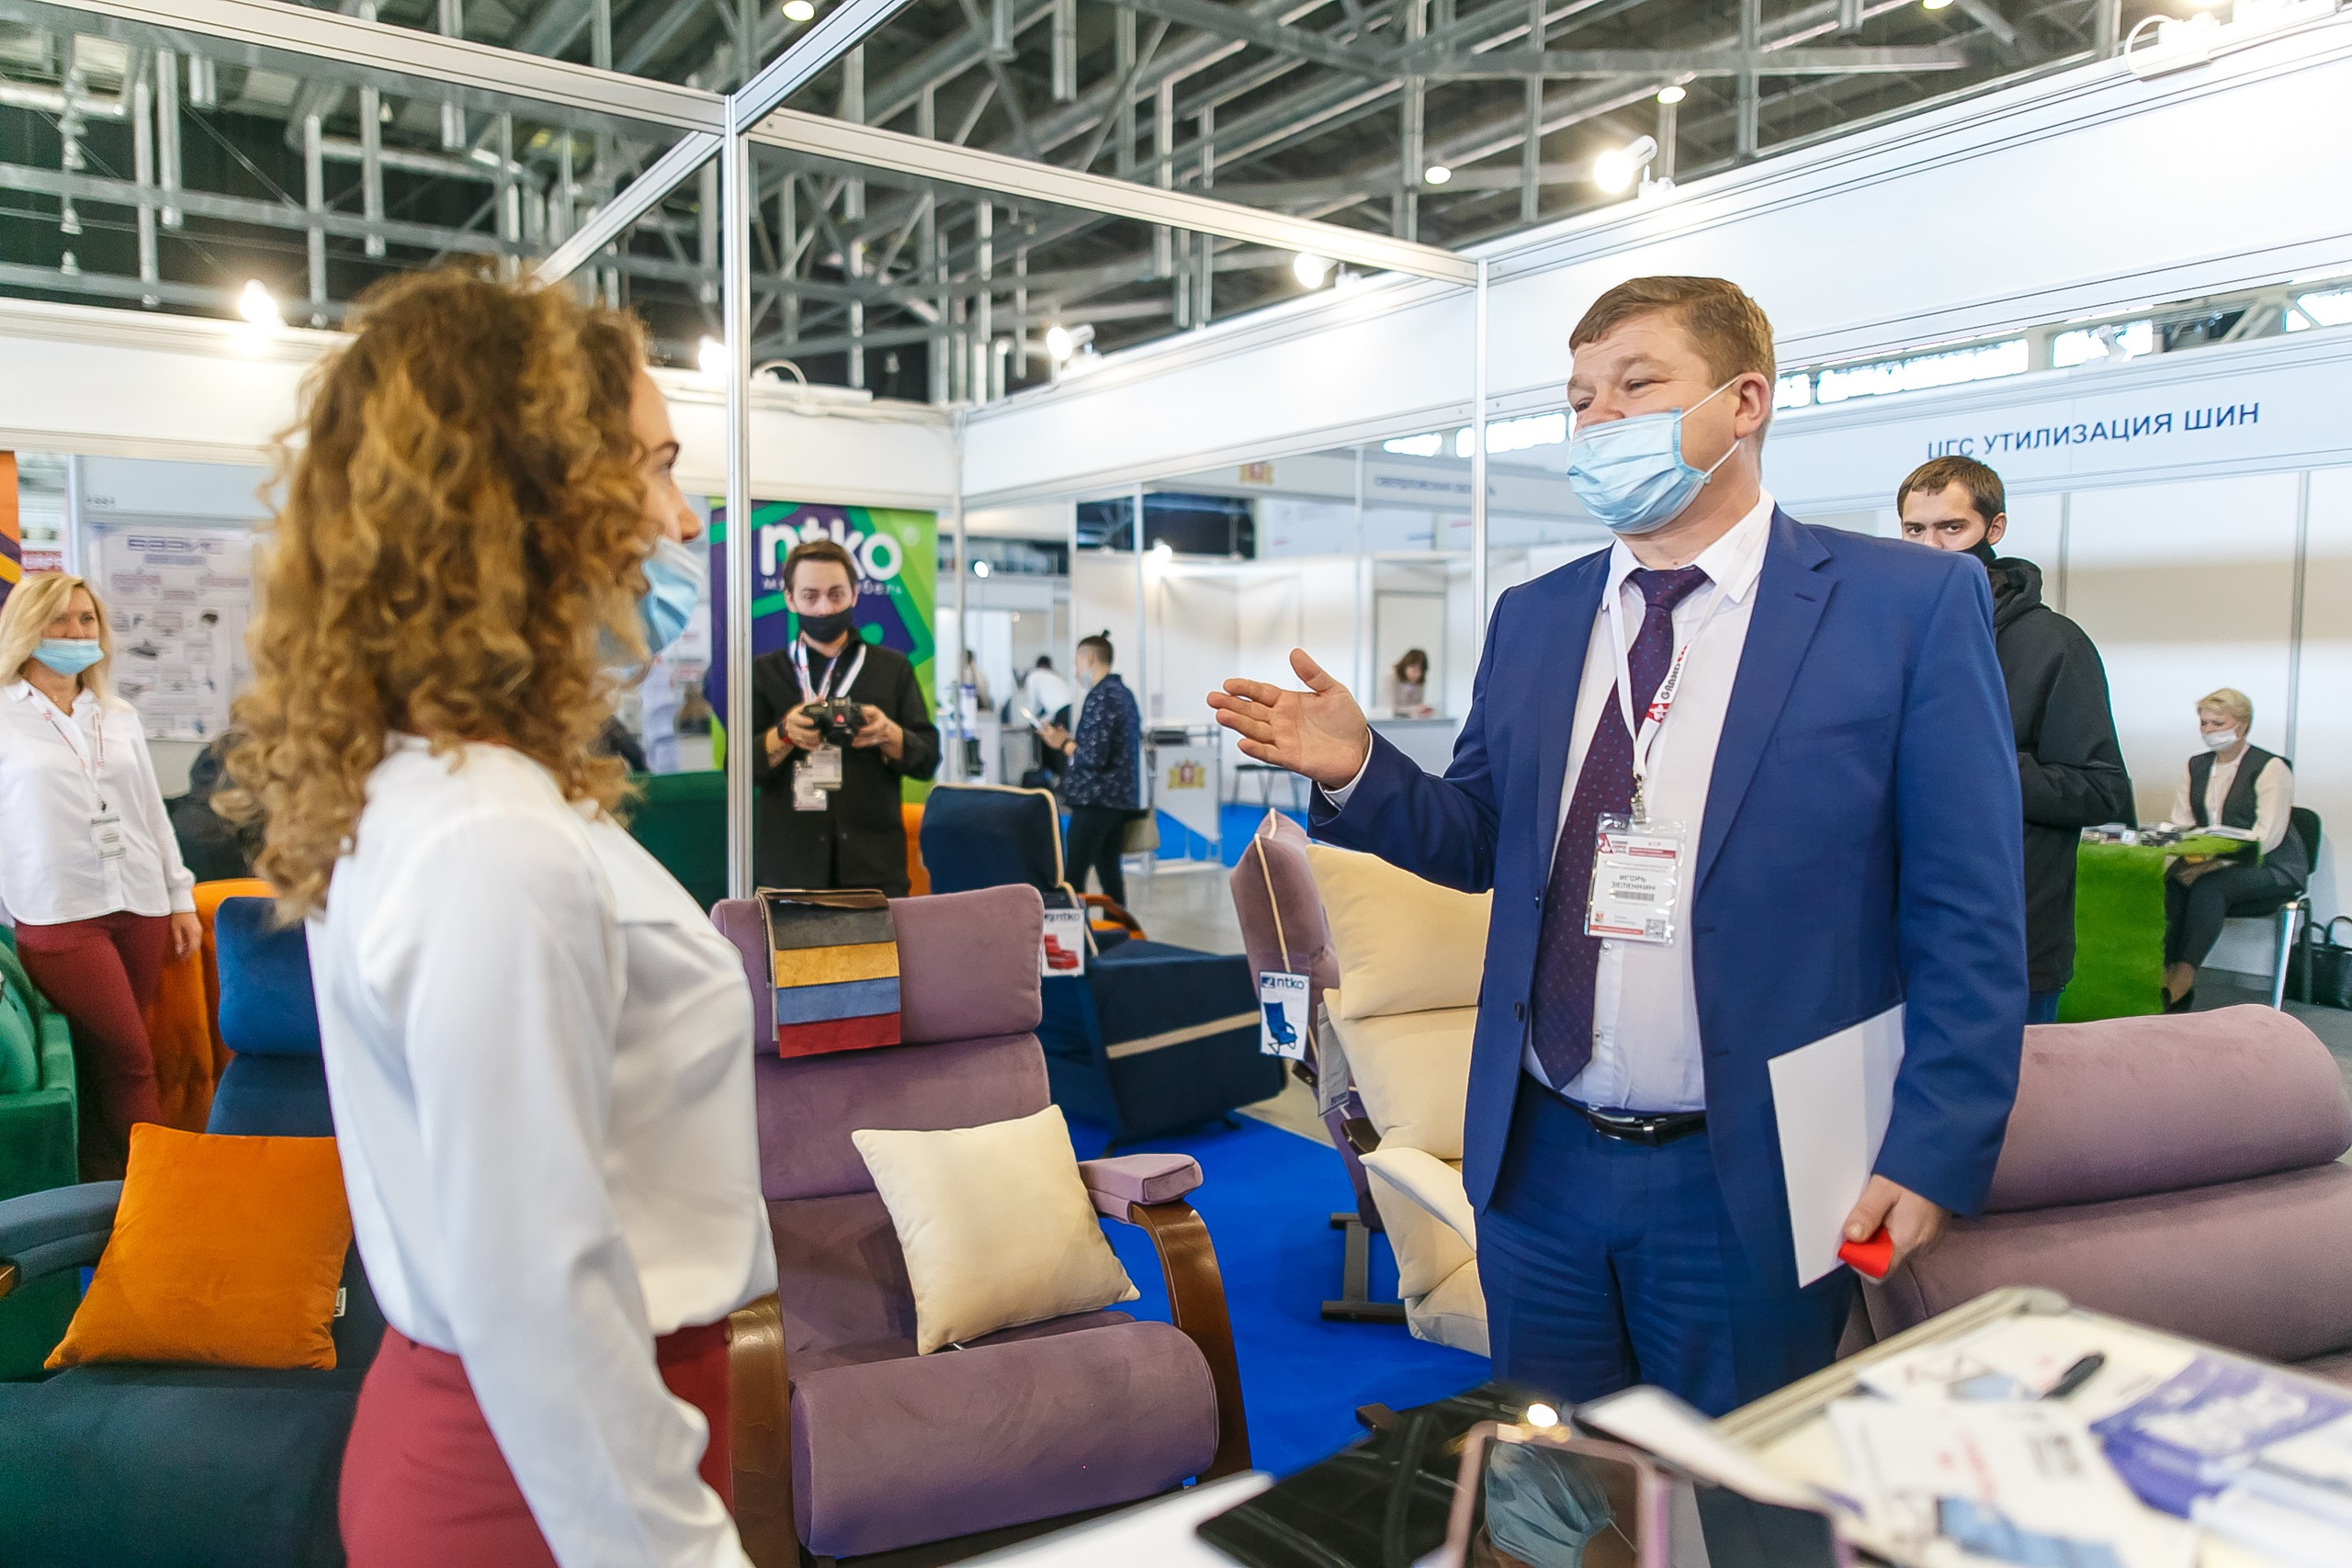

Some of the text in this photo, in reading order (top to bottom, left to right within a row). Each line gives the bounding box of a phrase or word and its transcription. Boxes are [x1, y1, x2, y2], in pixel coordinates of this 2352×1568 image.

[1984, 412, 2173, 455] УТИЛИЗАЦИЯ
[2184, 402, 2260, 431] ШИН
[760, 516, 903, 581] ntko
[1276, 976, 1305, 990] ntko
